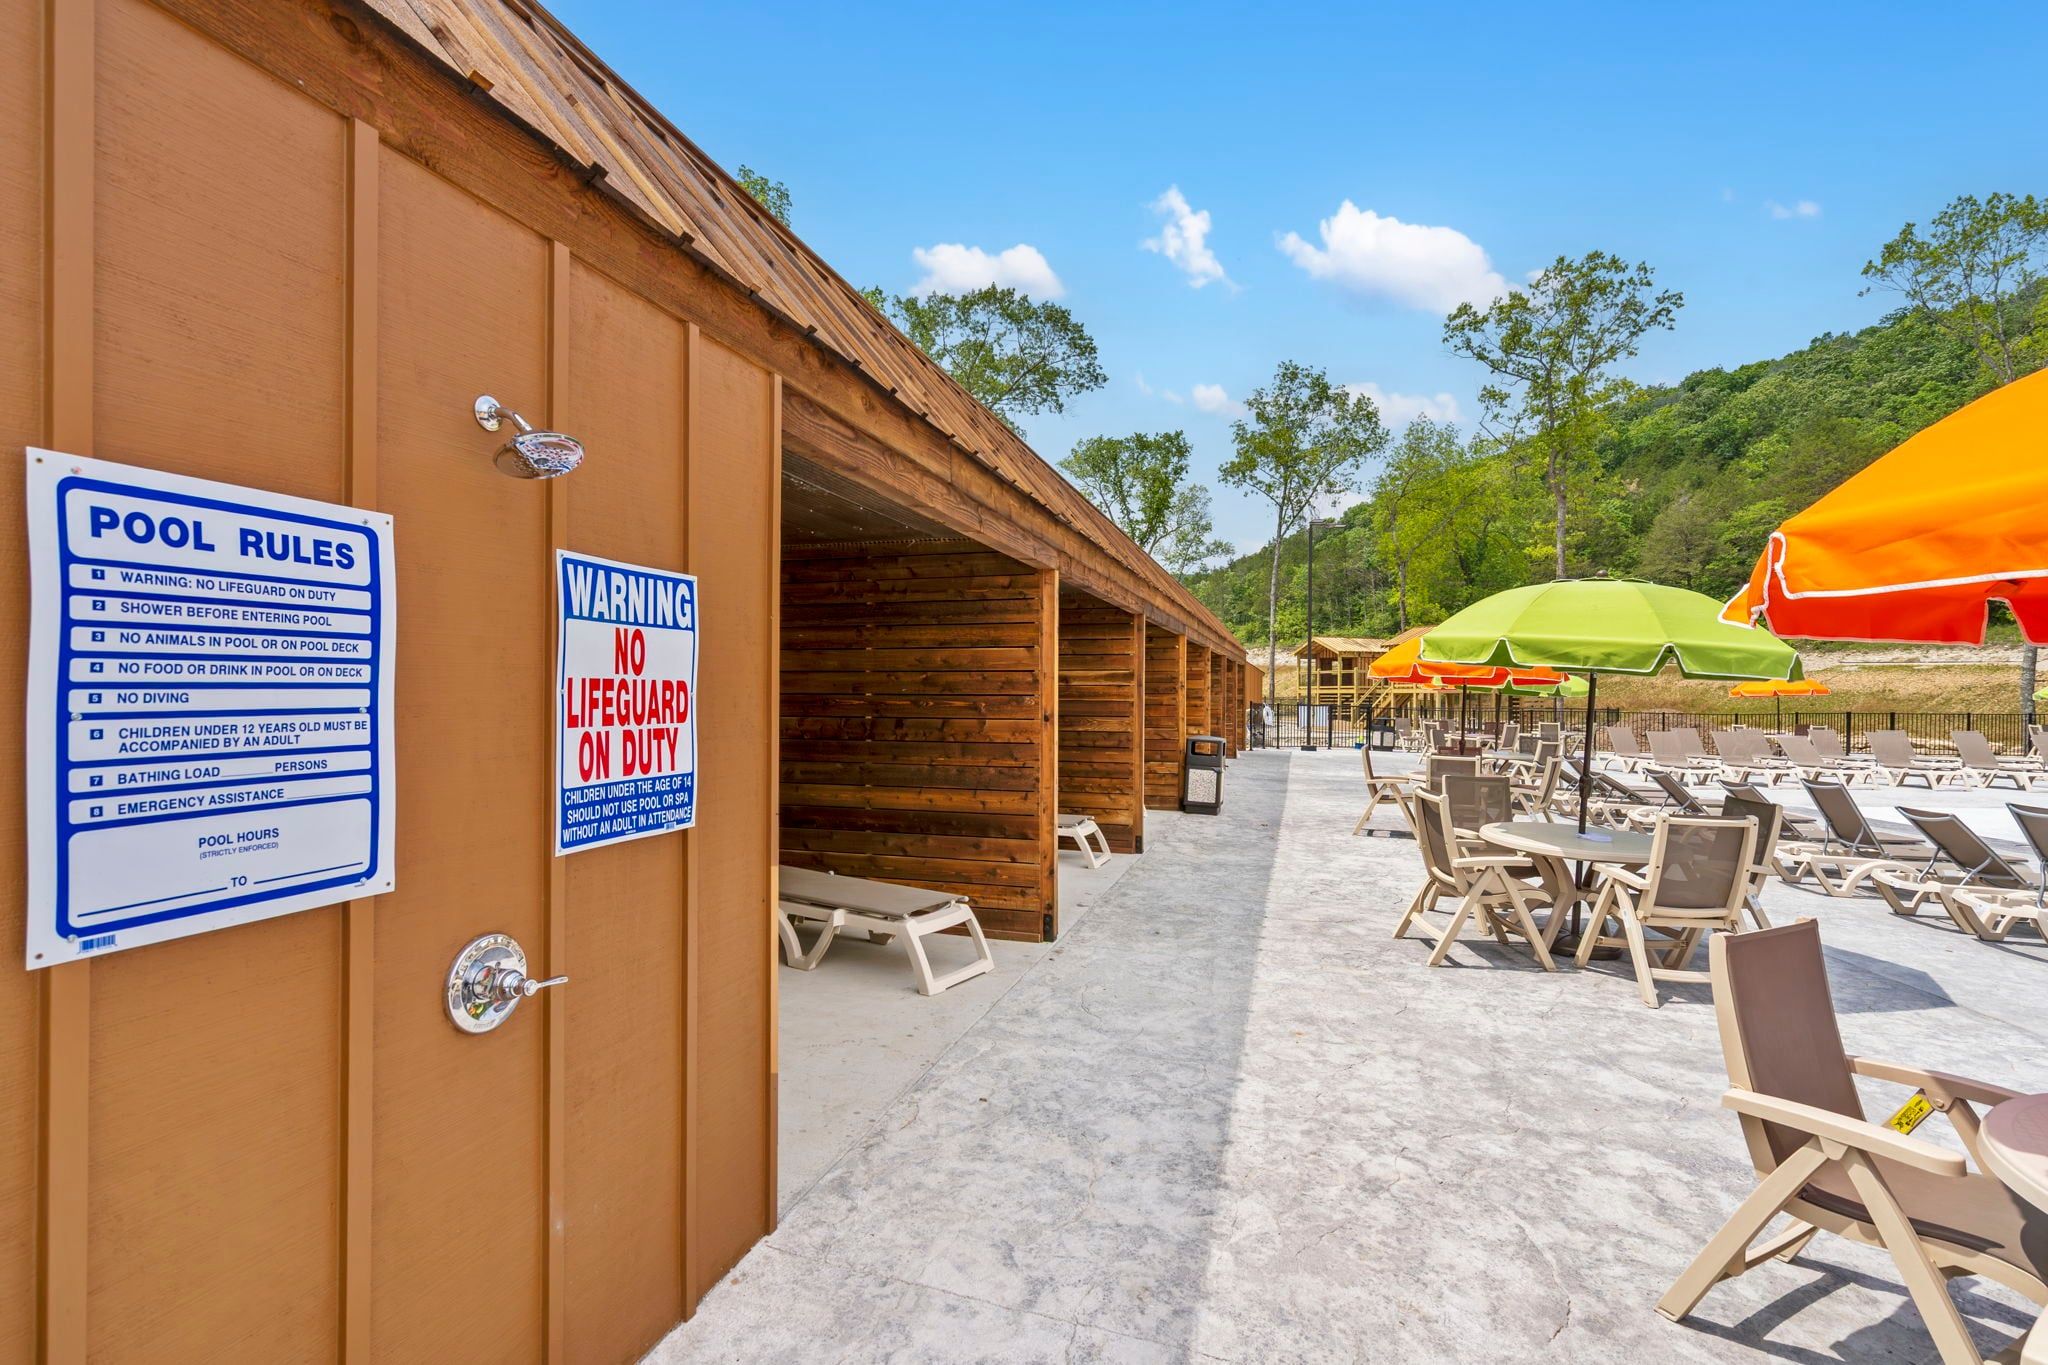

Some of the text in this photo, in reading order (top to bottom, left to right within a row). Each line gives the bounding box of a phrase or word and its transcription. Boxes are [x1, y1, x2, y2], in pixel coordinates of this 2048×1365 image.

[89, 505, 356, 570] POOL RULES
[120, 570, 192, 589] WARNING:
[196, 578, 215, 591] NO
[218, 581, 286, 598] LIFEGUARD
[289, 587, 306, 600] ON
[308, 589, 336, 602] DUTY
[566, 563, 692, 629] WARNING
[120, 601, 183, 617] SHOWER
[186, 606, 239, 620] BEFORE
[242, 610, 300, 625] ENTERING
[303, 615, 332, 627] POOL
[120, 632, 141, 644] NO
[145, 633, 206, 647] ANIMALS
[209, 636, 221, 647] IN
[225, 637, 258, 649] POOL
[261, 639, 278, 650] OR
[281, 640, 297, 651] ON
[300, 640, 329, 652] POOL
[331, 643, 360, 653] DECK
[614, 627, 646, 677] NO
[118, 662, 140, 674] NO
[144, 663, 183, 675] FOOD
[187, 664, 206, 675] OR
[209, 664, 248, 676] DRINK
[251, 665, 262, 676] IN
[265, 666, 297, 677] POOL
[299, 666, 315, 677] OR
[317, 667, 333, 677] ON
[335, 668, 363, 678] DECK
[117, 693, 139, 704] NO
[143, 693, 190, 704] DIVING
[567, 677, 689, 728] LIFEGUARD
[118, 726, 190, 739] CHILDREN
[194, 724, 238, 736] UNDER
[242, 724, 255, 734] 12
[258, 722, 297, 733] YEARS
[299, 722, 321, 732] OLD
[323, 721, 352, 731] MUST
[354, 720, 368, 730] BE
[118, 734, 301, 753] ACCOMPANIED BY AN ADULT
[579, 727, 678, 783] ON DUTY
[117, 769, 181, 785] BATHING
[184, 766, 220, 780] LOAD
[275, 759, 328, 773] PERSONS
[117, 796, 205, 815] EMERGENCY
[208, 788, 285, 806] ASSISTANCE
[564, 775, 692, 805] CHILDREN UNDER THE AGE OF 14
[567, 792, 688, 824] SHOULD NOT USE POOL OR SPA
[562, 806, 691, 843] WITHOUT AN ADULT IN ATTENDANCE
[198, 827, 280, 849] POOL HOURS
[199, 841, 280, 861] (STRICTLY ENFORCED)
[230, 876, 248, 887] TO
